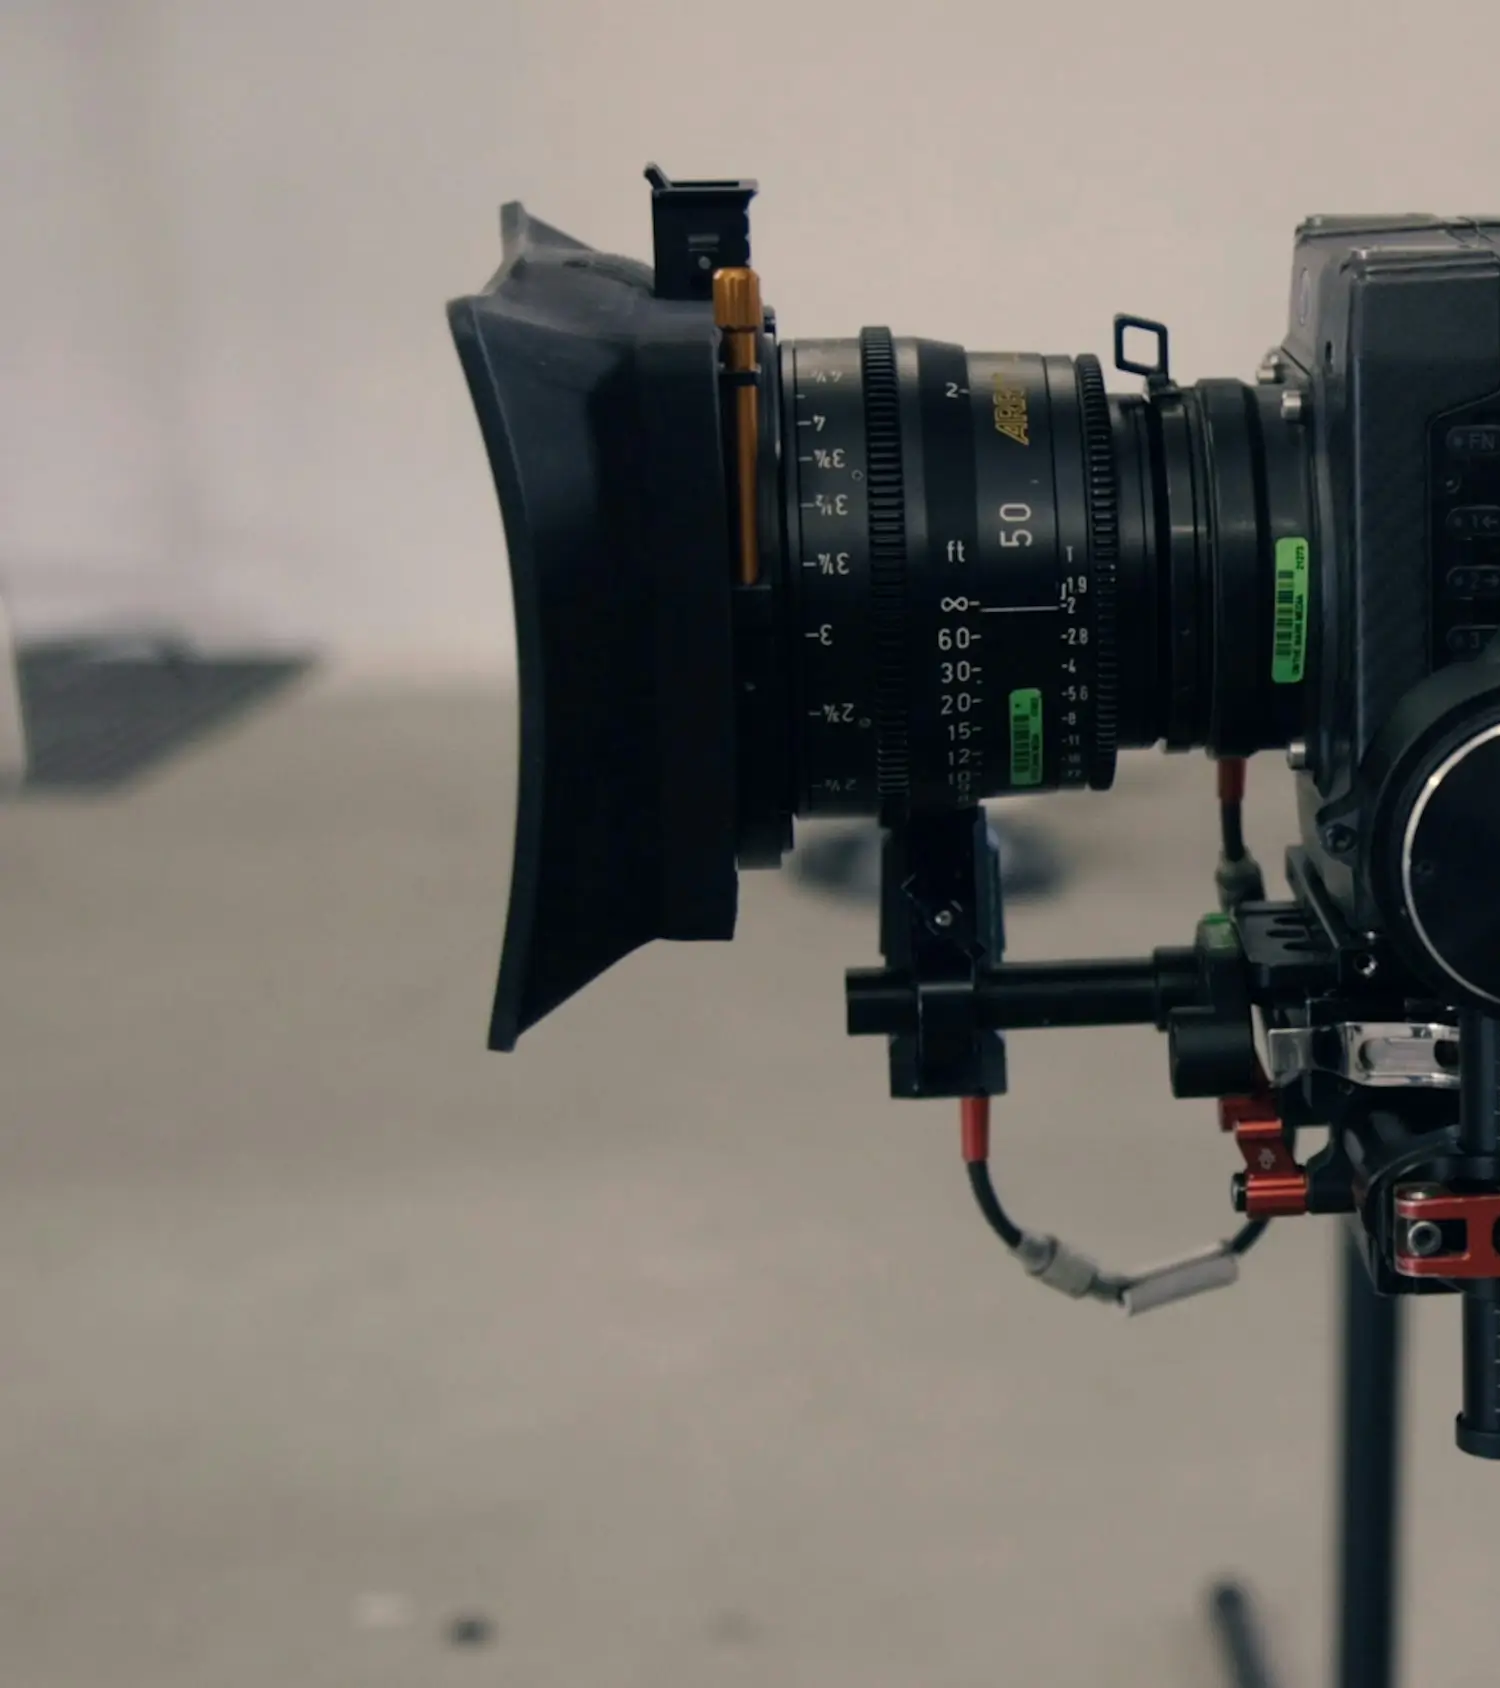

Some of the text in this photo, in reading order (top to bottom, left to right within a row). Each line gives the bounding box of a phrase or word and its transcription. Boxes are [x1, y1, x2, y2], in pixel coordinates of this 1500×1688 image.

[945, 382, 959, 398] 2
[812, 414, 826, 432] 4
[1000, 503, 1033, 547] 50
[946, 540, 966, 563] ft
[1067, 596, 1076, 615] 2
[819, 623, 833, 646] 3
[937, 626, 971, 651] 60
[940, 660, 972, 684] 30
[1068, 658, 1076, 675] 4
[940, 691, 972, 716] 20
[947, 720, 972, 743] 15
[947, 747, 971, 767] 12
